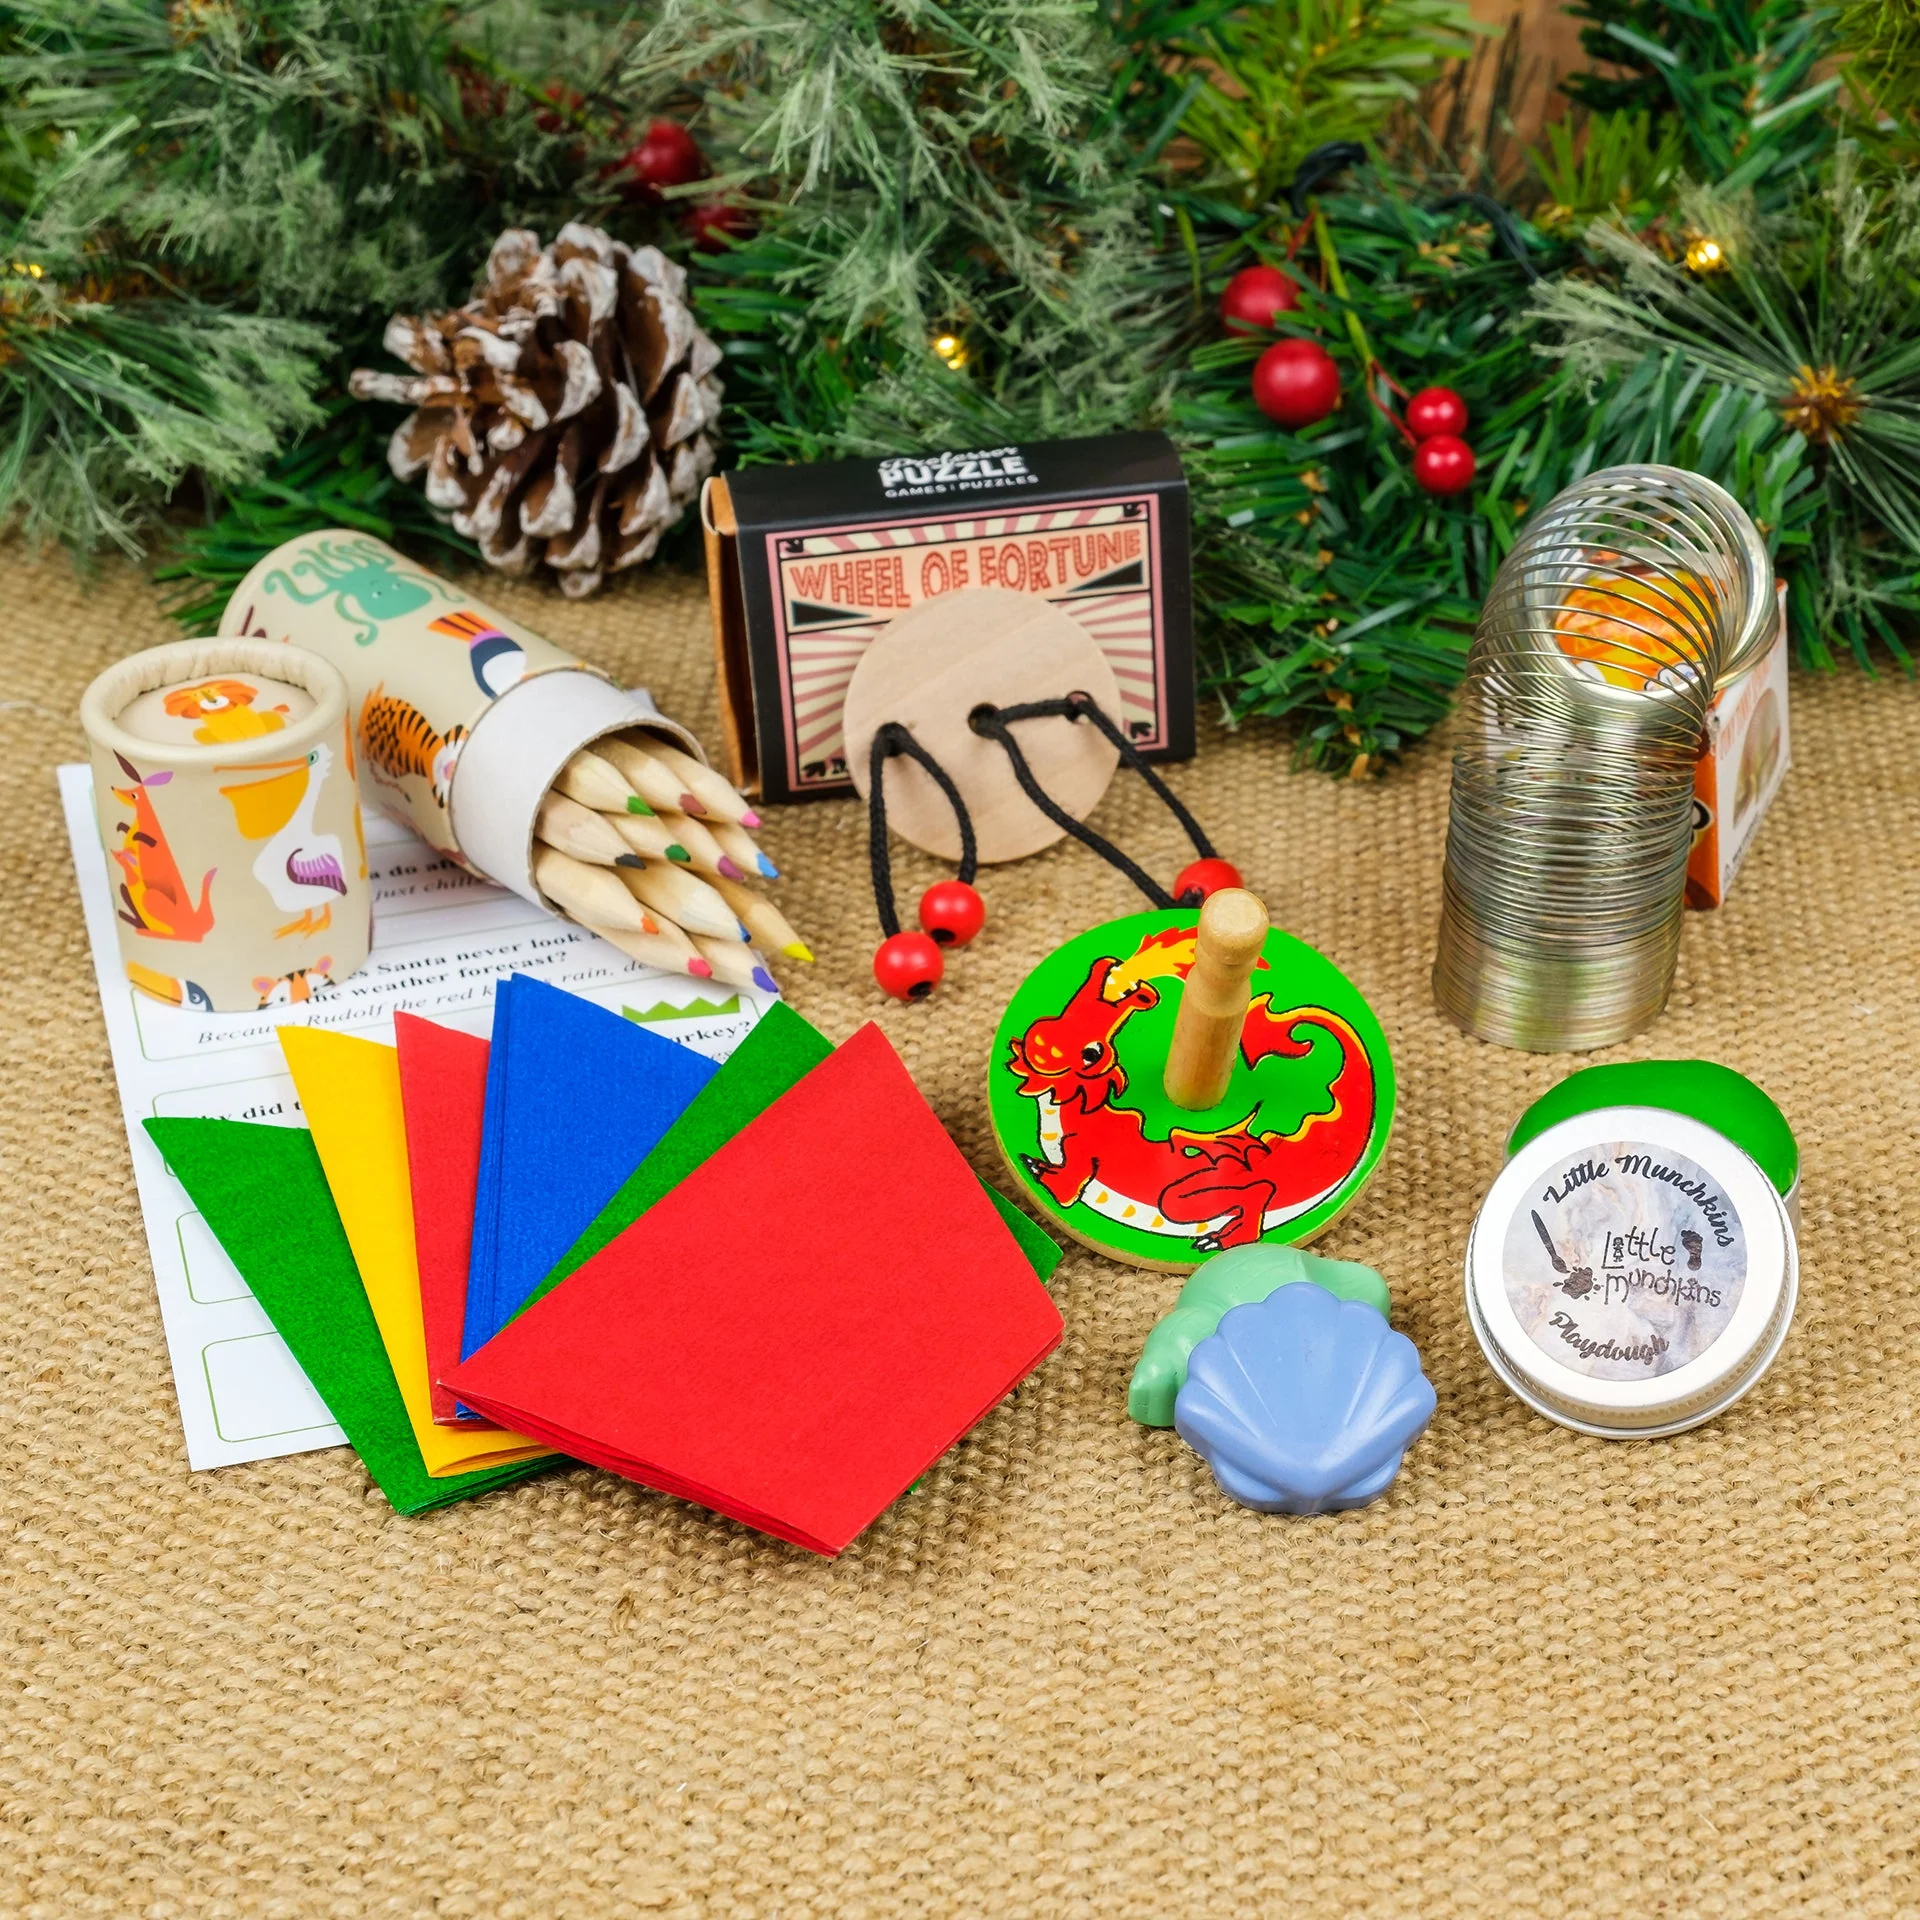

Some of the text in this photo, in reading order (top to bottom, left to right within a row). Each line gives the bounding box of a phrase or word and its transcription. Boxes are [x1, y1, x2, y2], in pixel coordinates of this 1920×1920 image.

[878, 456, 1029, 488] PUZZLE
[885, 474, 1039, 498] GAMES PUZZLES
[790, 529, 1142, 608] WHEEL OF FORTUNE
[352, 972, 451, 996] weather
[459, 951, 566, 978] forecast?
[377, 957, 447, 975] Santa
[457, 943, 522, 961] never
[531, 932, 581, 949] look
[198, 1022, 297, 1044] Becau
[307, 1003, 387, 1026] Rudolf
[393, 998, 428, 1011] the
[436, 987, 473, 1004] red
[672, 1021, 750, 1043] urkey?
[242, 1103, 284, 1120] did
[1543, 1153, 1735, 1248] Little Munchkins
[1549, 1311, 1670, 1365] Playdough
